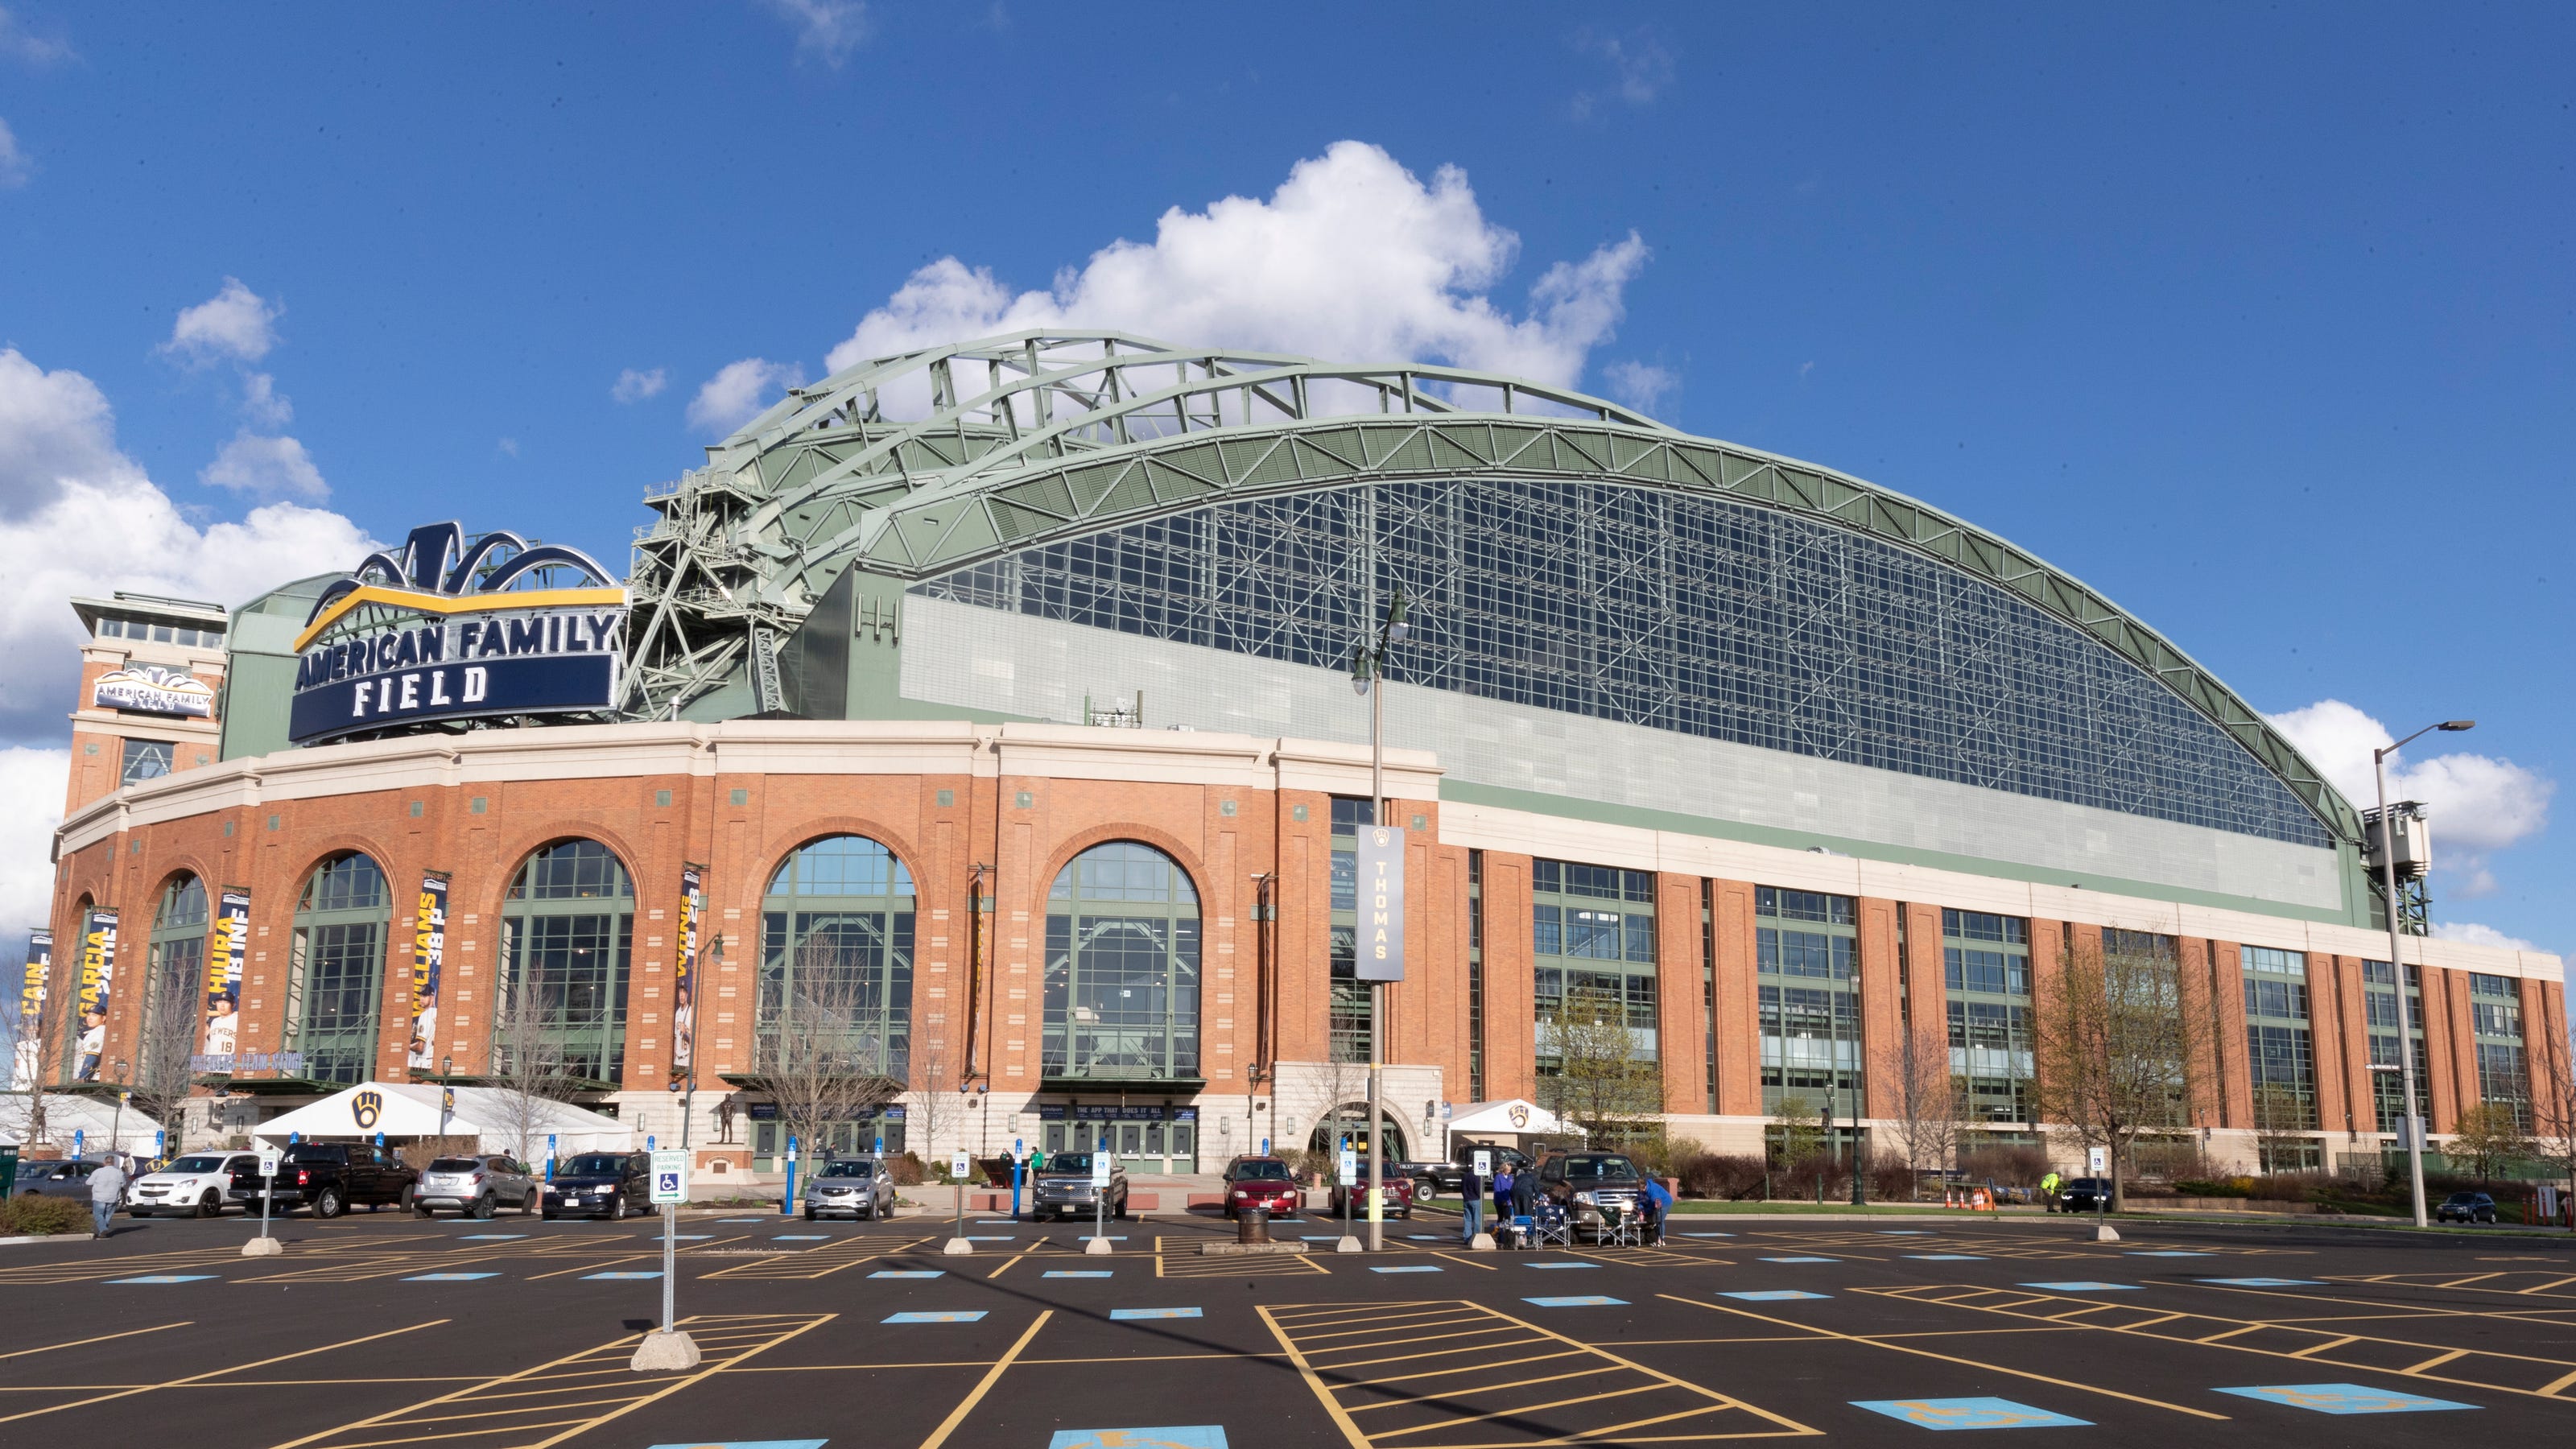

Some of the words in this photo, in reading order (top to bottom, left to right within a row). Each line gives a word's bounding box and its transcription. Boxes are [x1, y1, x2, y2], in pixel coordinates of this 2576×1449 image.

[295, 623, 448, 691] AMERICAN
[460, 614, 621, 658] FAMILY
[98, 686, 161, 700] AMERICAN
[167, 693, 209, 704] FAMILY
[129, 698, 175, 710] FIELD
[353, 667, 488, 716] FIELD
[228, 908, 249, 950] INF
[430, 908, 445, 925] P
[1373, 861, 1388, 960] THOMAS
[208, 917, 235, 993] HIURA
[427, 932, 444, 965] 38
[677, 895, 691, 977] WONG
[21, 963, 44, 1015] CAIN
[223, 957, 243, 984] 18
[221, 1041, 232, 1052] 18
